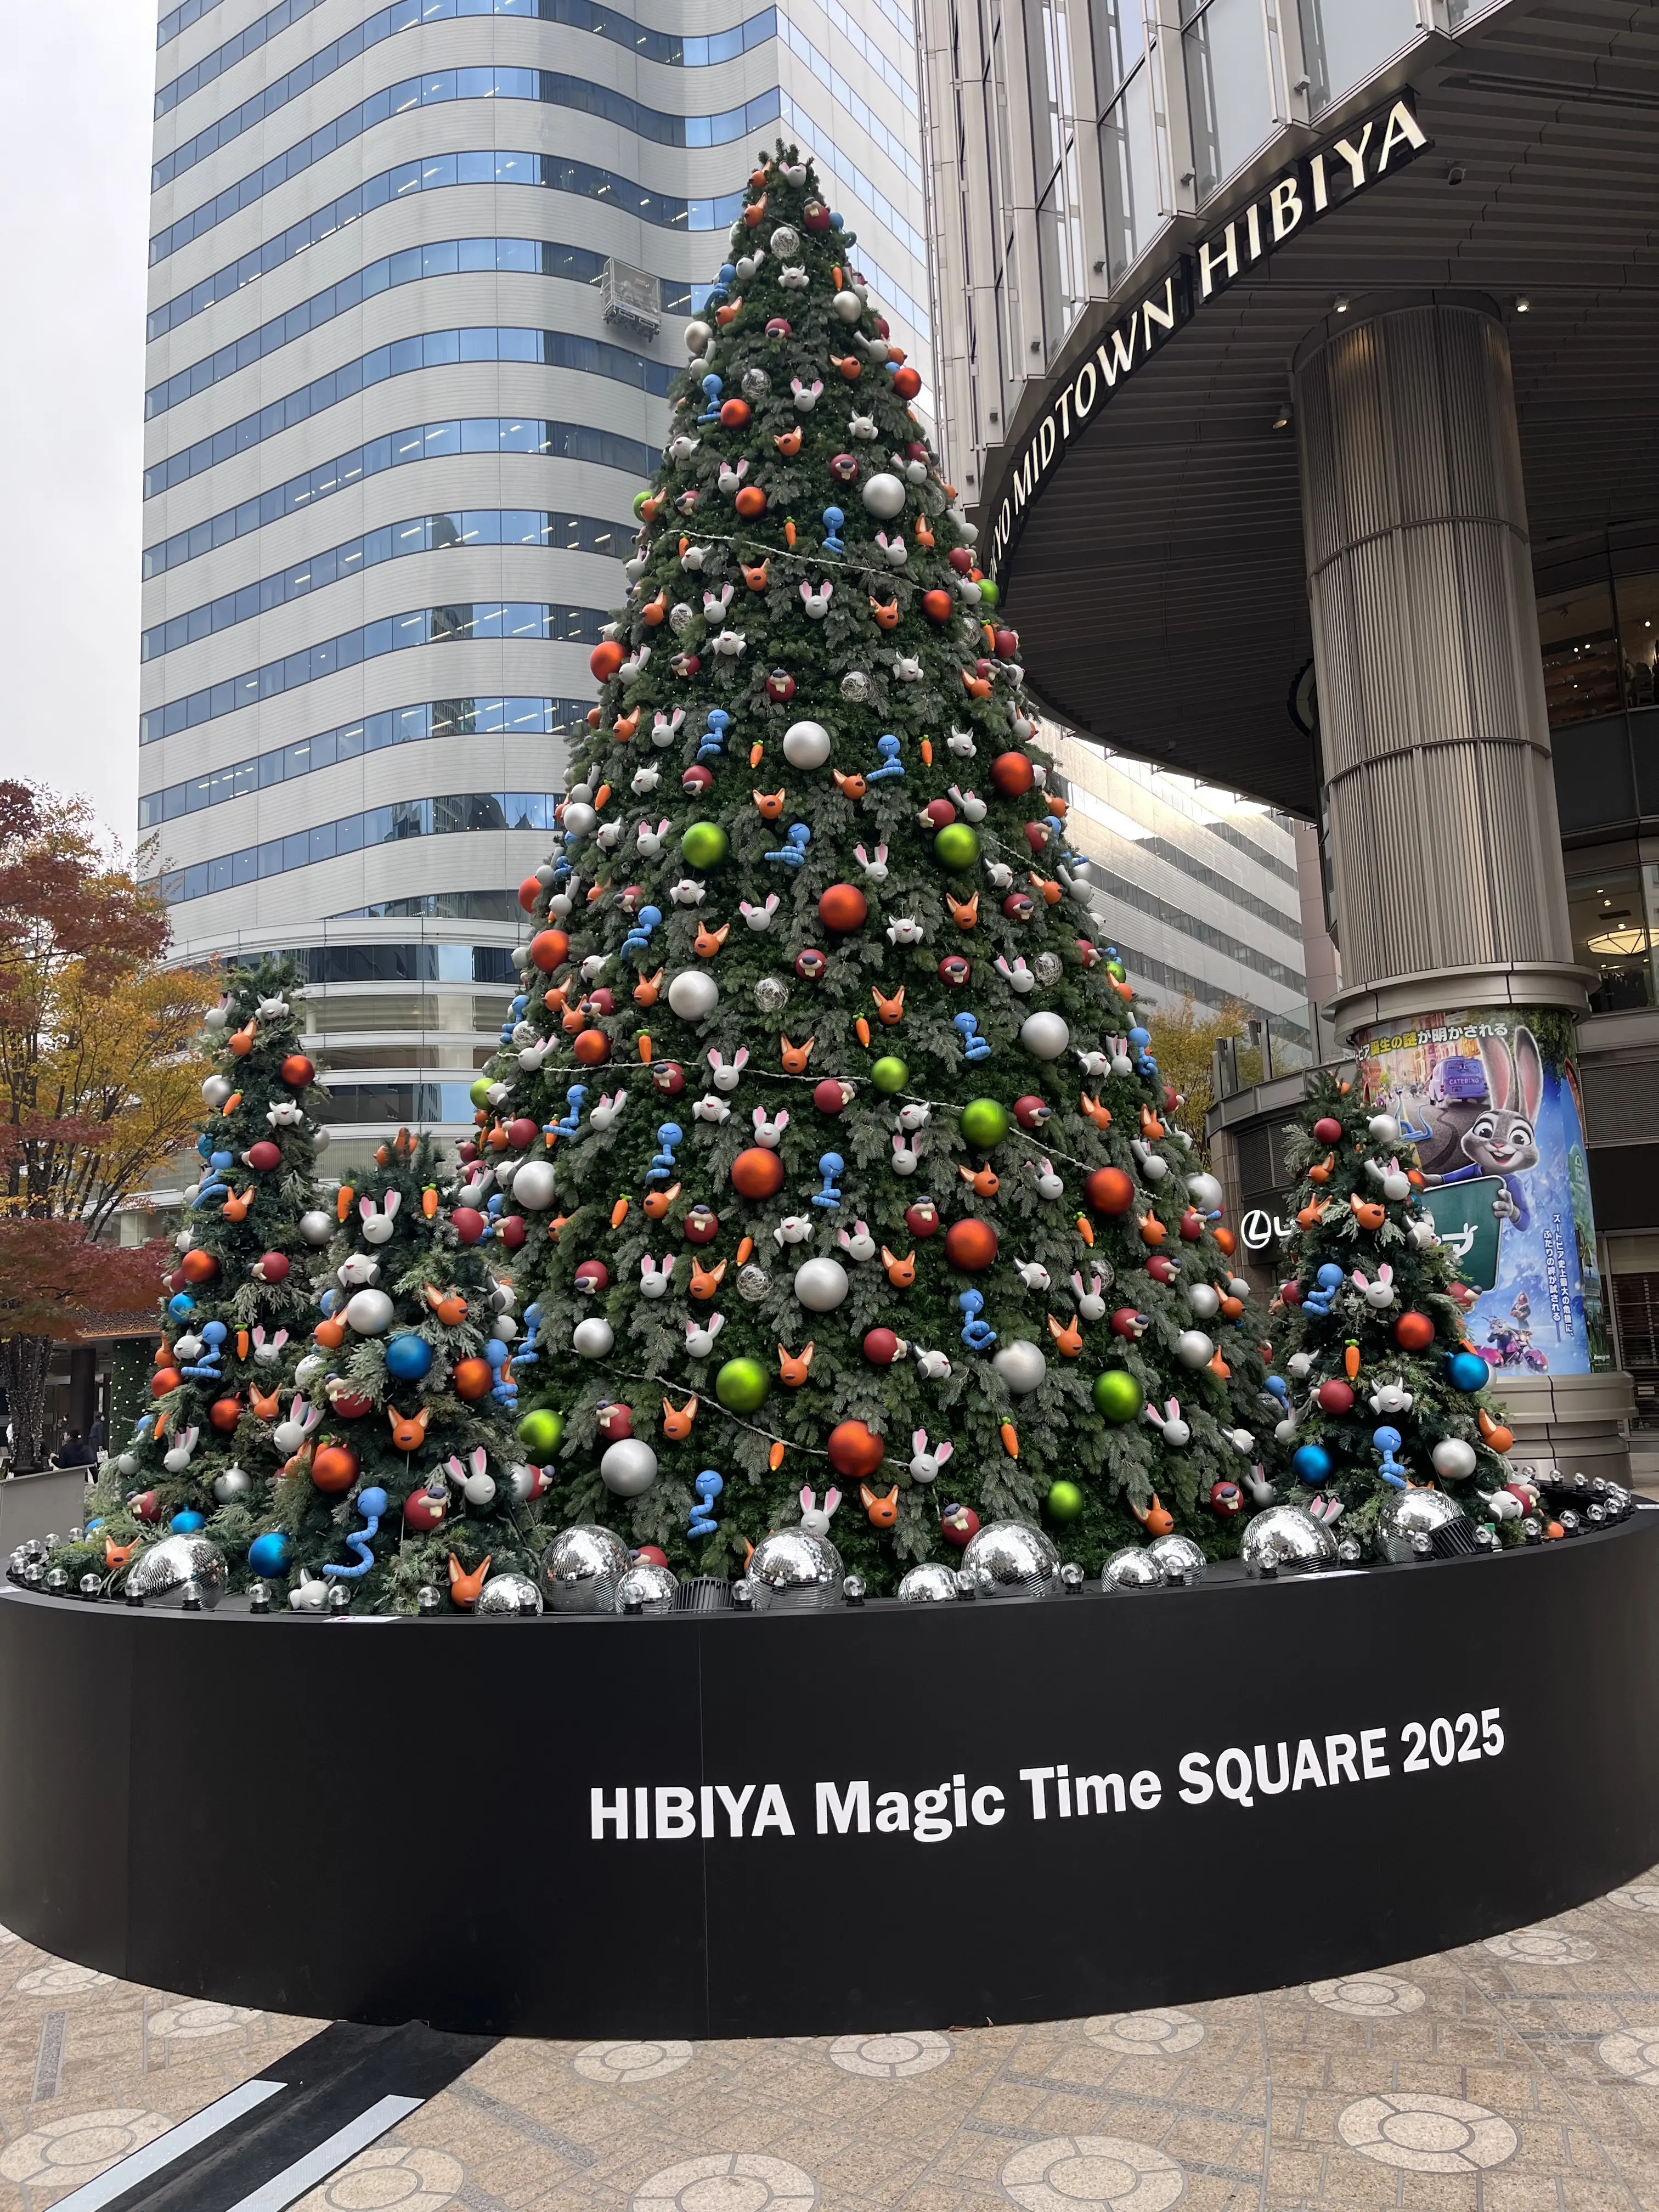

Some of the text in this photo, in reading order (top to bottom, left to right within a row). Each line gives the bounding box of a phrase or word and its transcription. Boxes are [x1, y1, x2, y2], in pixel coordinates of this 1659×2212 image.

[1013, 277, 1175, 516] MIDTOWN
[1198, 100, 1427, 299] HIBIYA
[590, 1707, 1504, 1843] HIBIYA Magic Time SQUARE 2025
